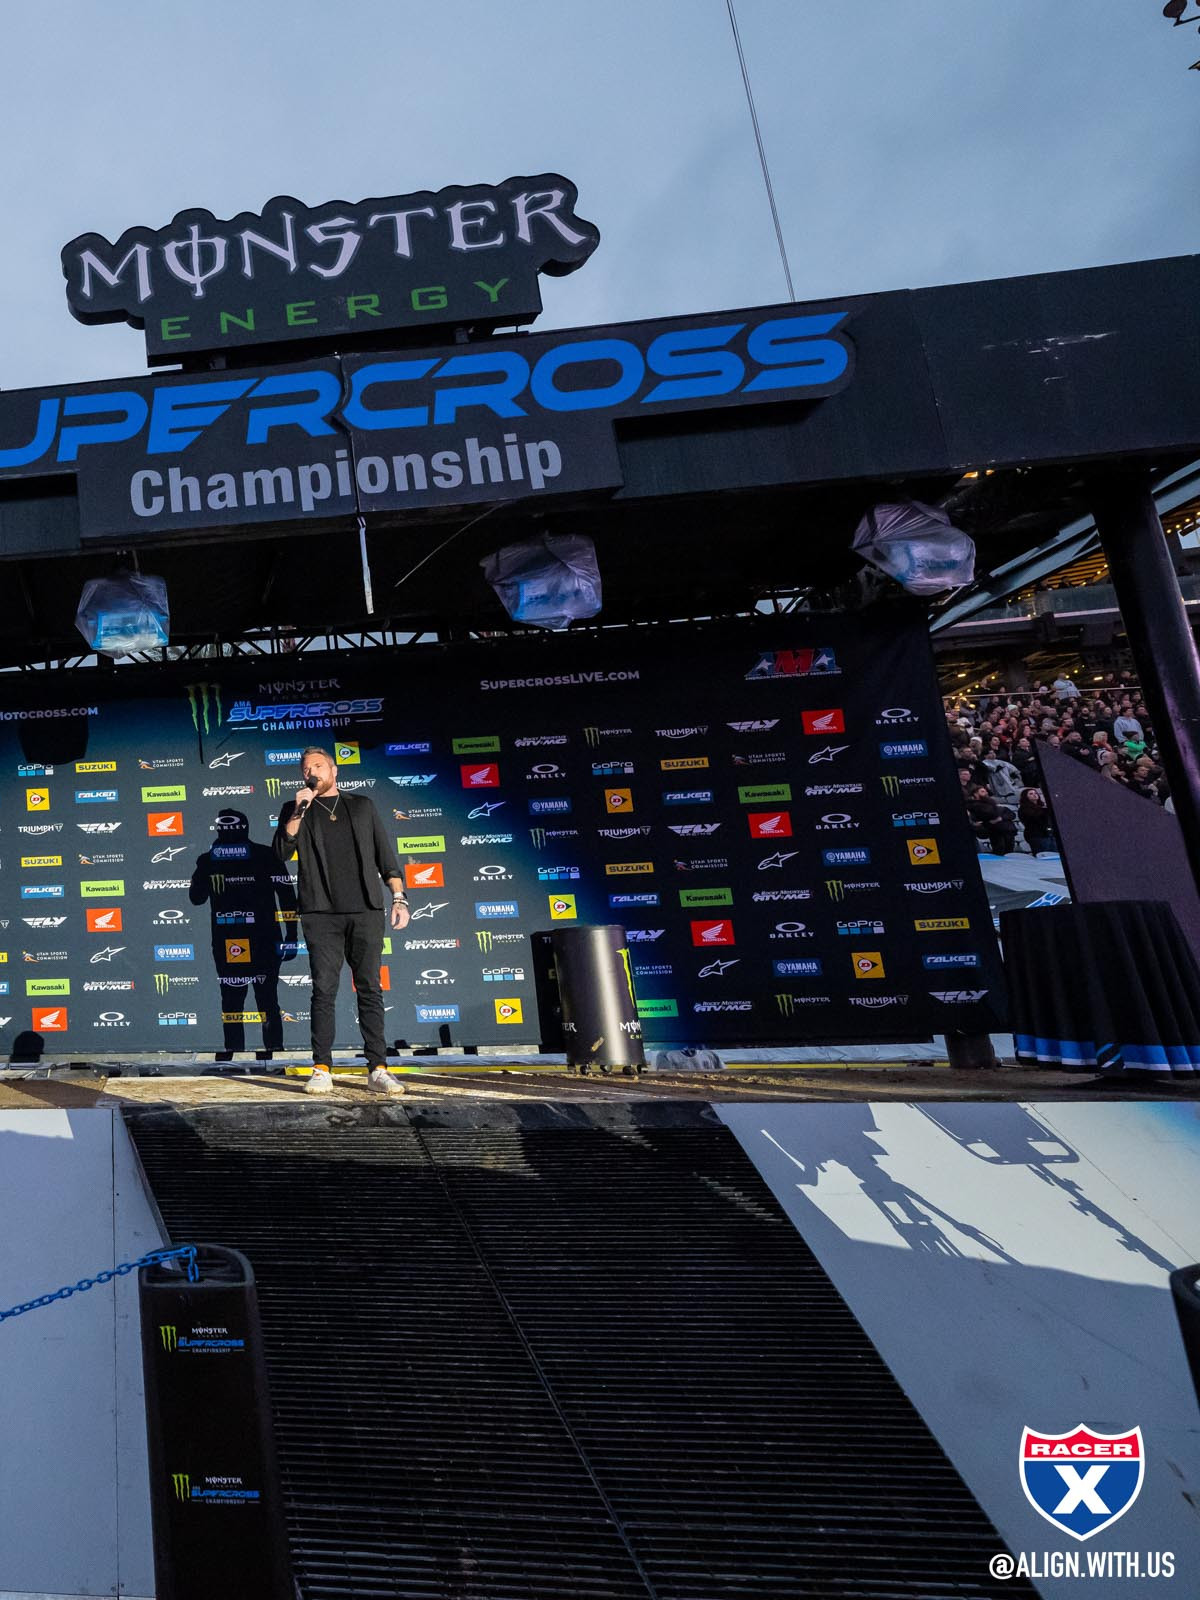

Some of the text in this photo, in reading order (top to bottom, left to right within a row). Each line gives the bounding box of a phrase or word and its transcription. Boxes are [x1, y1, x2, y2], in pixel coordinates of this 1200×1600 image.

[79, 189, 587, 302] MONSTER
[160, 278, 510, 341] ENERGY
[130, 434, 563, 518] Championship
[227, 698, 384, 722] SUPERCROSS
[263, 717, 350, 731] CHAMPIONSHIP
[741, 719, 780, 729] FLY
[655, 728, 697, 738] TRIUMPH
[892, 744, 923, 753] YAMAHA
[79, 763, 113, 771] SUZUKI
[592, 761, 633, 769] GoPro
[664, 759, 705, 768] SUZUKI
[402, 774, 437, 784] FLY
[78, 791, 116, 799] FALKEN
[146, 790, 181, 798] Kawasaki
[666, 792, 711, 800] FALKEN
[745, 790, 784, 798] Kawasaki
[540, 801, 568, 810] YAMAHA
[892, 812, 938, 820] GoPro
[18, 825, 54, 835] TRIUMPH
[87, 822, 122, 831] FLY
[683, 823, 721, 833] FLY
[598, 827, 641, 838] TRIUMPH
[403, 841, 440, 849] Kawasaki
[221, 847, 246, 855] YAMAHA
[835, 851, 866, 860] YAMAHA
[537, 866, 579, 874] GoPro
[609, 864, 650, 873] SUZUKI
[24, 887, 62, 895] FALKEN
[86, 885, 119, 893] Kawasaki
[904, 882, 951, 893] TRIUMPH
[612, 895, 657, 903] FALKEN
[686, 893, 726, 902] Kawasaki
[487, 905, 514, 913] YAMAHA
[34, 917, 67, 925] FLY
[919, 920, 965, 929] SUZUKI
[165, 947, 191, 956] YAMAHA
[926, 955, 977, 964] FALKEN
[483, 967, 523, 975] GoPro
[786, 962, 817, 971] YAMAHA
[218, 977, 256, 987] TRIUMPH
[31, 983, 65, 991] Kawasaki
[946, 990, 988, 1001] FLY
[849, 997, 897, 1008] TRIUMPH
[428, 1008, 455, 1017] YAMAHA
[638, 1005, 672, 1013] awasaki
[225, 1013, 263, 1021] SUZUKI
[192, 1327, 228, 1335] MONSTER
